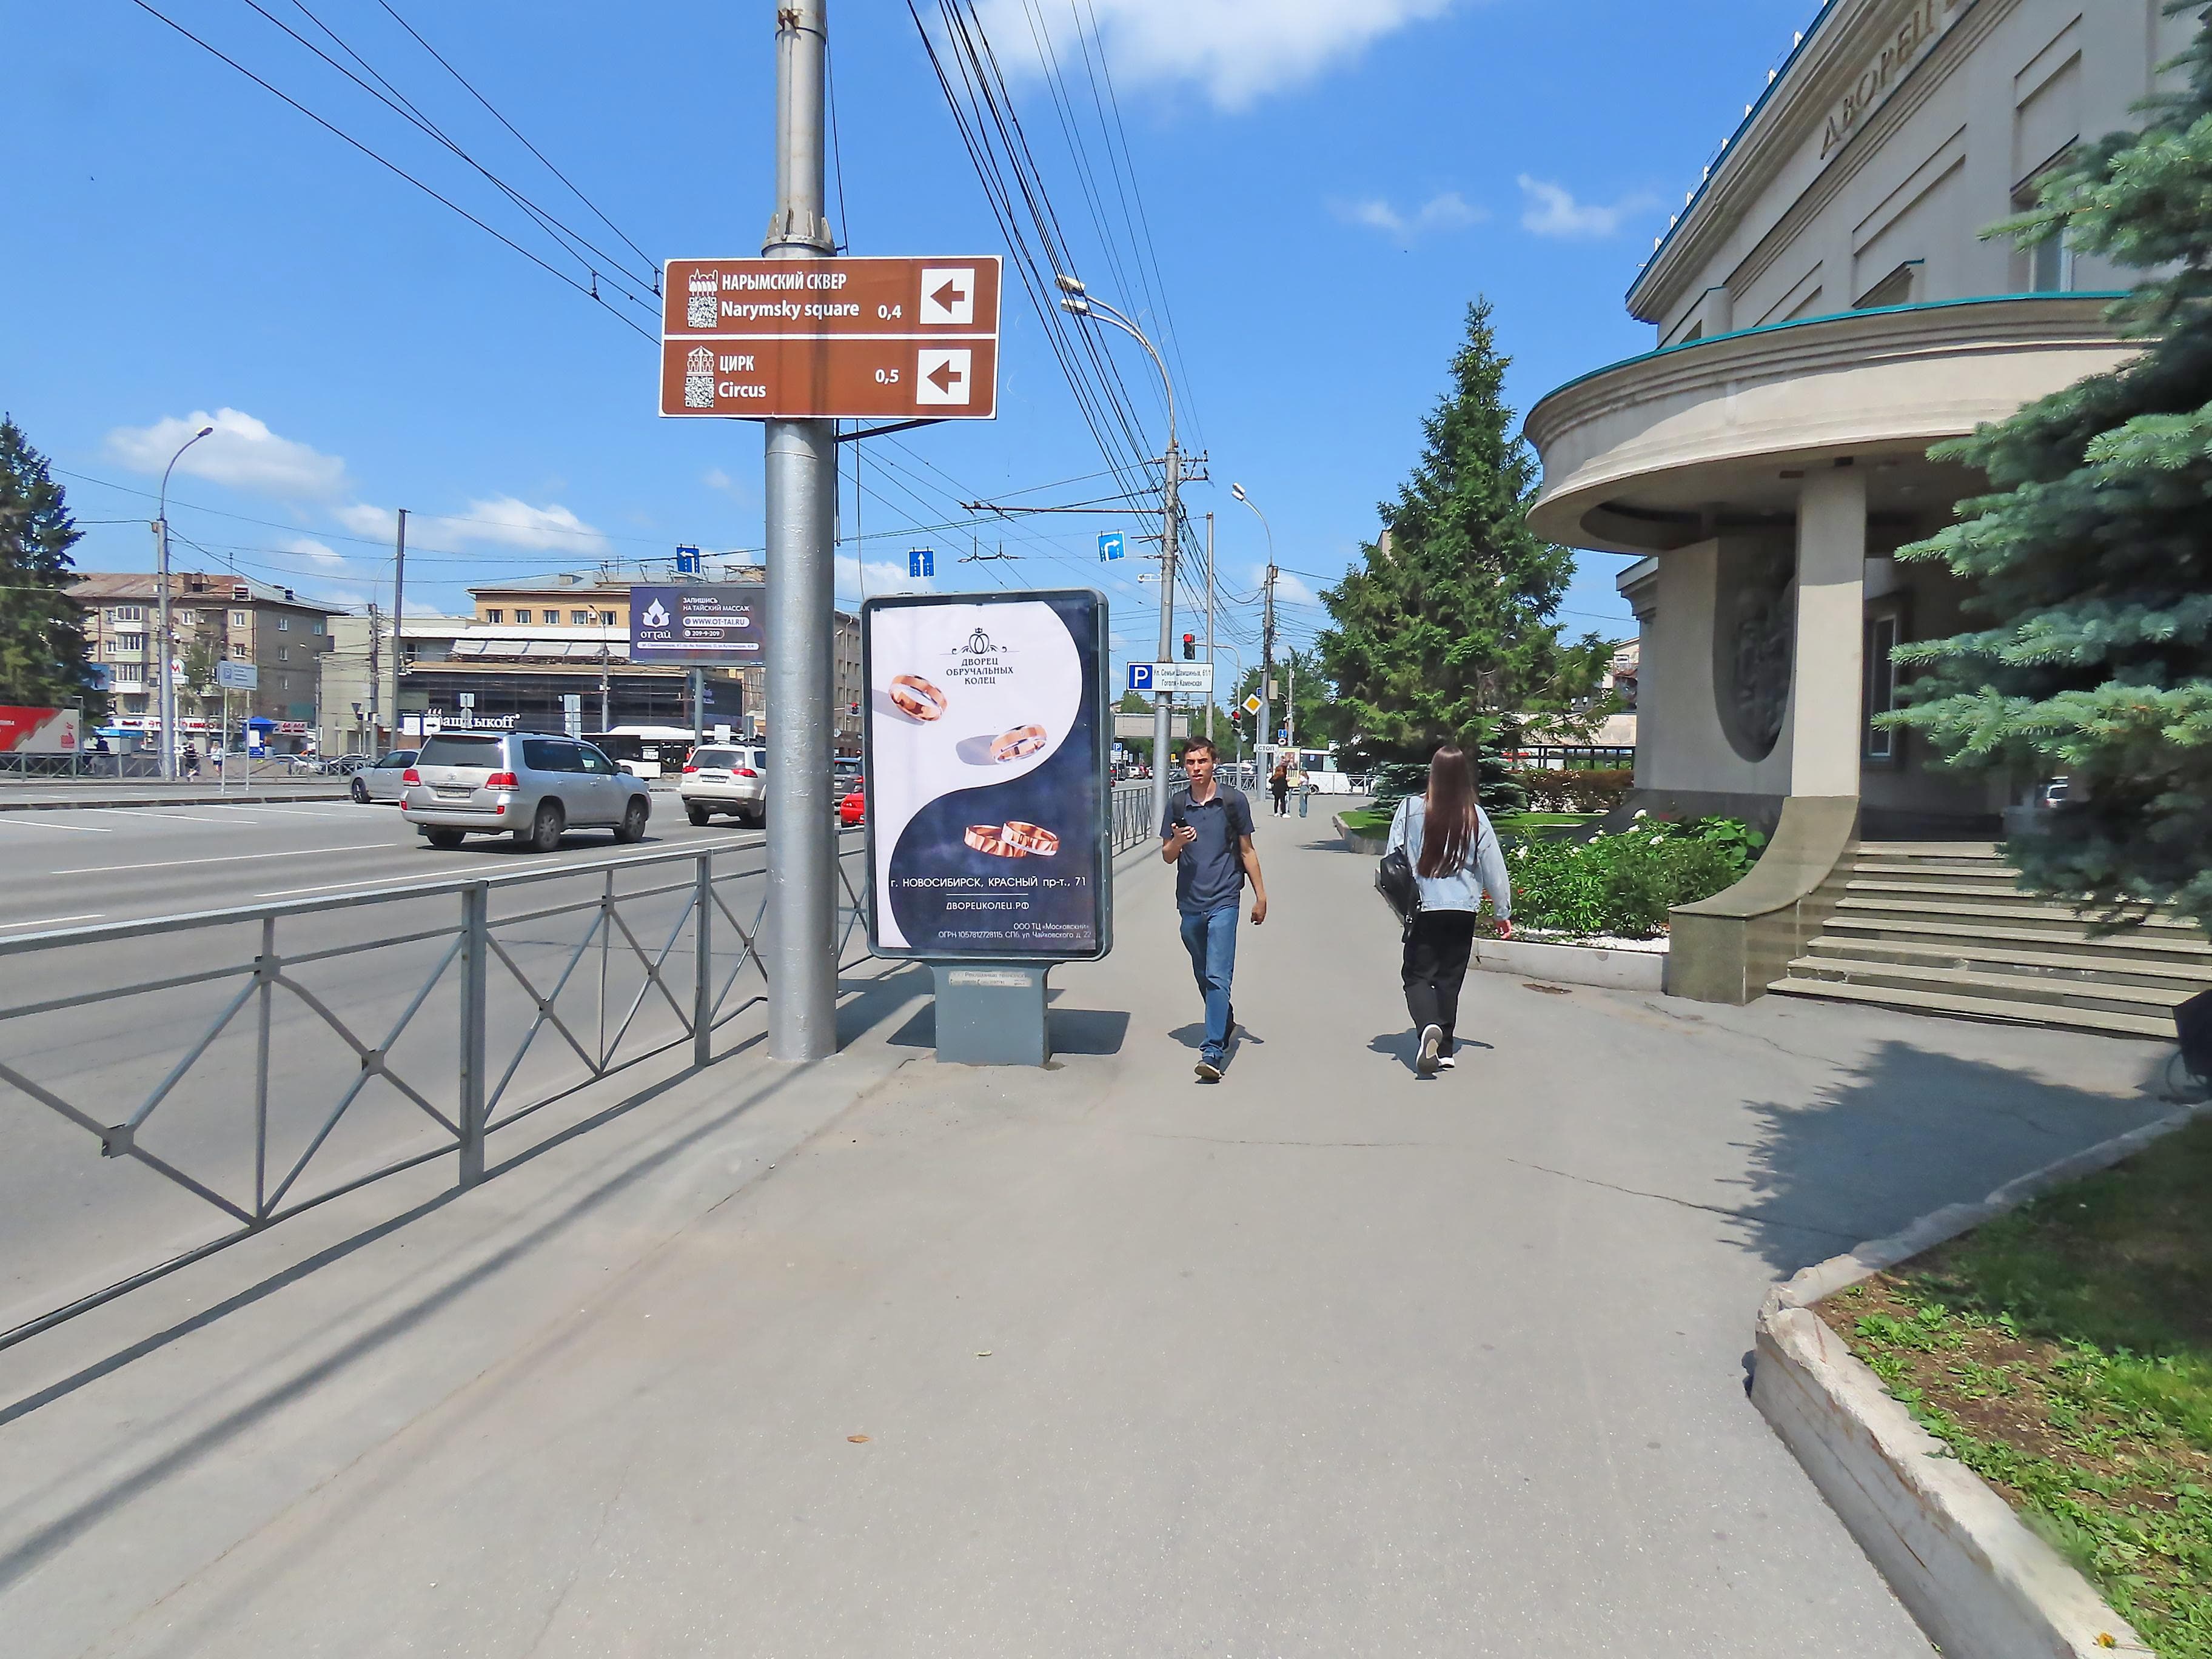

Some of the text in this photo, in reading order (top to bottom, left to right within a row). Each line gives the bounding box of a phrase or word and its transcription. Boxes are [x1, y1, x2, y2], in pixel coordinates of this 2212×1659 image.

[722, 271, 847, 290] НАРЫМСКИЙ СКВЕР
[720, 301, 902, 320] Narymsky square 0,4
[720, 355, 754, 374] ЦИРК
[875, 369, 899, 384] 0,5
[719, 382, 766, 398] Circus
[961, 657, 998, 667] ДВОРЕЦ
[946, 666, 1013, 676] ОБРУЧАЛЬНЫХ
[964, 676, 996, 685] КОЛЕЦ
[441, 715, 515, 728] ашыкоff
[903, 877, 984, 888] НОВОСИБИРСК,
[988, 876, 1037, 886] КРАСНЫЙ
[1043, 878, 1070, 888] пр-т.,
[1075, 877, 1085, 886] 71
[946, 902, 1030, 910] ДВОРЕЦКОЛЕЦ.РФ
